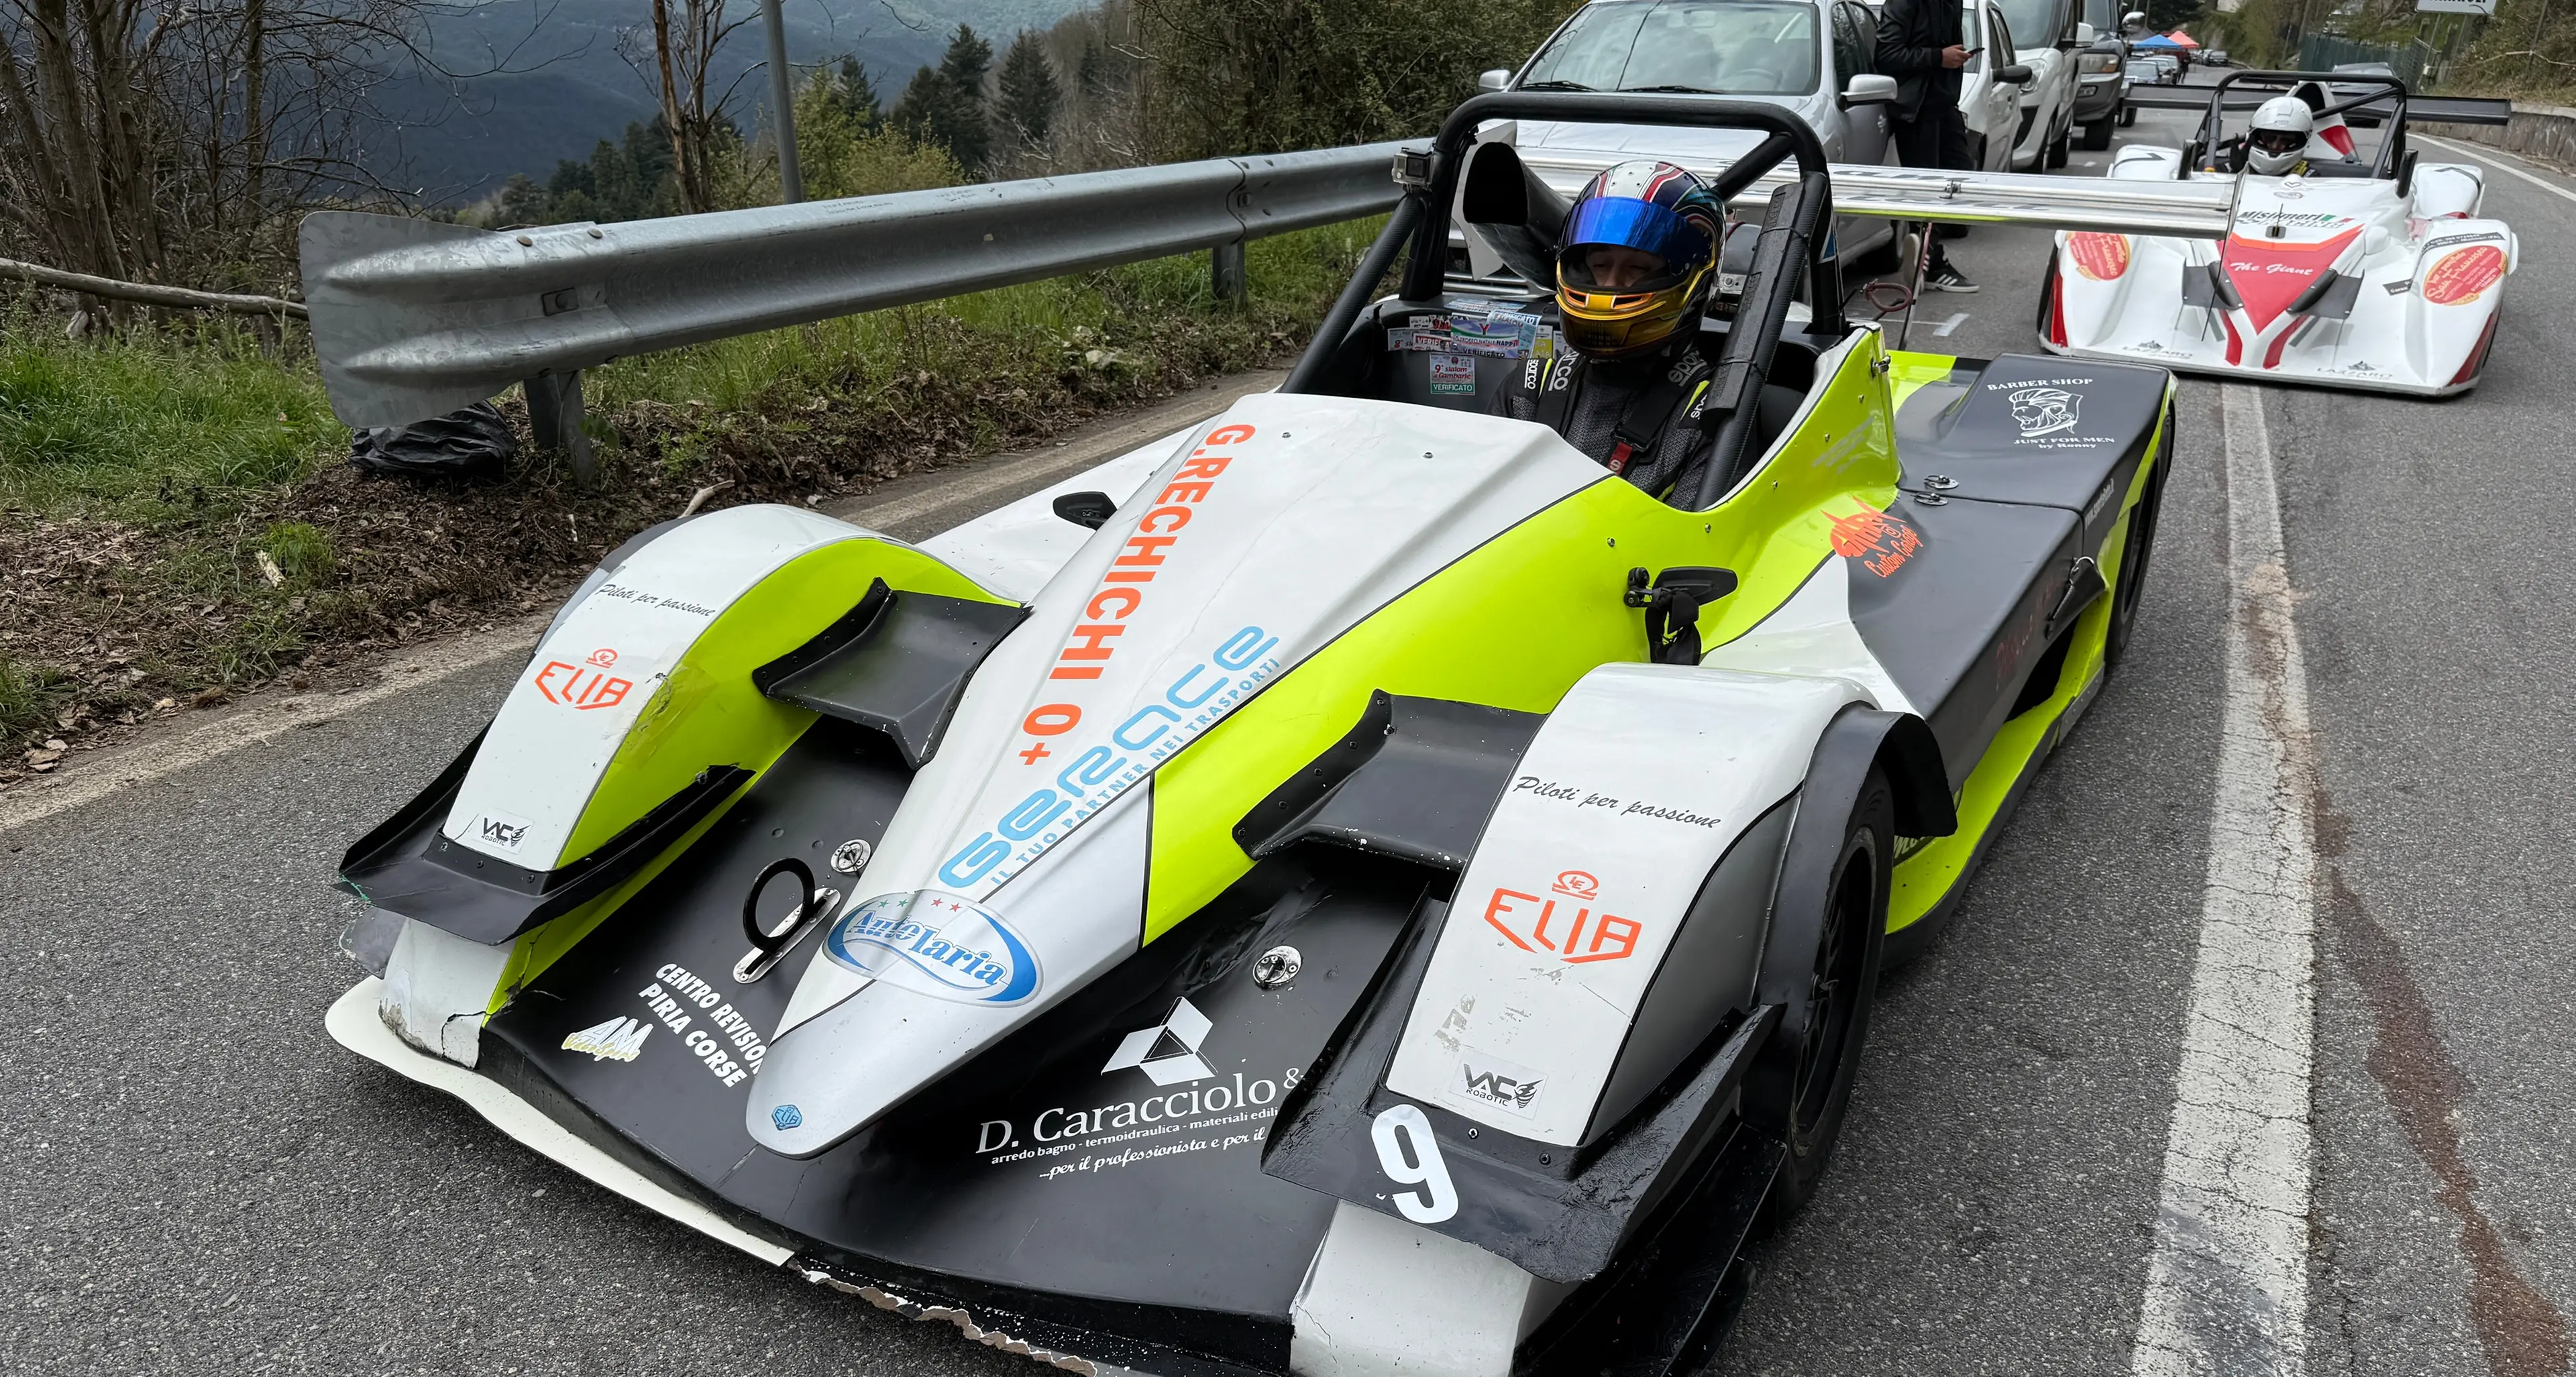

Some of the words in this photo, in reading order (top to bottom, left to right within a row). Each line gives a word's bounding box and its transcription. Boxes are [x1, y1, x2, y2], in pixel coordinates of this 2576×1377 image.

[2229, 262, 2260, 272] The
[2266, 263, 2314, 276] Giant
[1462, 348, 1505, 358] VERIFICATO
[1433, 383, 1473, 392] VERIFICATO
[1986, 380, 2049, 391] BARBER
[2051, 378, 2094, 386] SHOP
[1049, 424, 1256, 679] G.RECHICHI
[596, 584, 638, 603] Piloti
[635, 592, 658, 606] per
[657, 596, 716, 618] passione
[990, 869, 1014, 885] IL
[1016, 832, 1058, 864] TUO
[1061, 762, 1149, 829] PARTNER
[1150, 734, 1184, 762] NEI
[1185, 657, 1281, 732] TRASPORTI
[1513, 776, 1580, 802] Piloti
[1580, 791, 1618, 810] per
[1621, 800, 1722, 830] passione
[655, 962, 720, 1009] CENTRO
[638, 982, 692, 1035] PIRIA
[685, 1030, 748, 1088] CORSE
[975, 1119, 1019, 1154] D.
[1032, 1072, 1277, 1143] Caracciolo
[1283, 1067, 1305, 1090] &
[1466, 1087, 1509, 1108] ROBOTIC
[991, 1148, 1035, 1164] arredo
[1037, 1142, 1076, 1158] bagno
[1085, 1123, 1181, 1148] termoidraulica
[1189, 1111, 1248, 1130] materiali
[1077, 1155, 1091, 1171] il
[1093, 1138, 1208, 1172] professionista
[1210, 1138, 1218, 1148] e
[1222, 1130, 1250, 1150] per
[1252, 1127, 1266, 1142] il
[1370, 1103, 1459, 1225] 9
